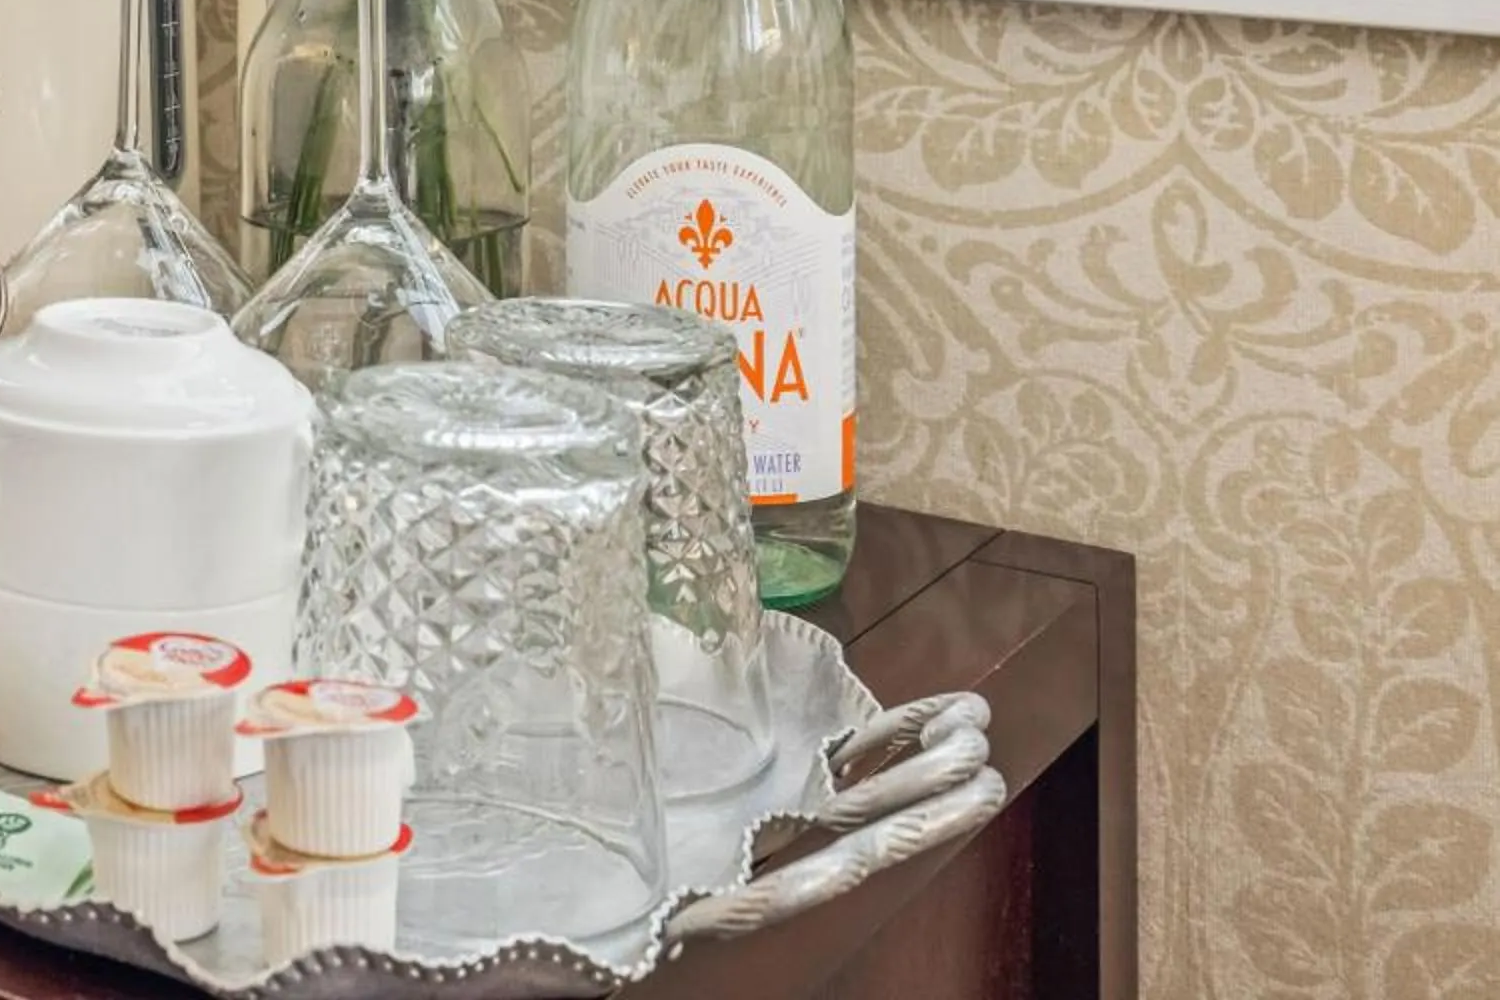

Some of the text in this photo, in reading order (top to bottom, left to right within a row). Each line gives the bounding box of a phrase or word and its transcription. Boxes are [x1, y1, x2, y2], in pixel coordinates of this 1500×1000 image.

[696, 159, 728, 173] TASTE
[655, 278, 764, 322] ACQUA
[753, 453, 801, 474] WATER
